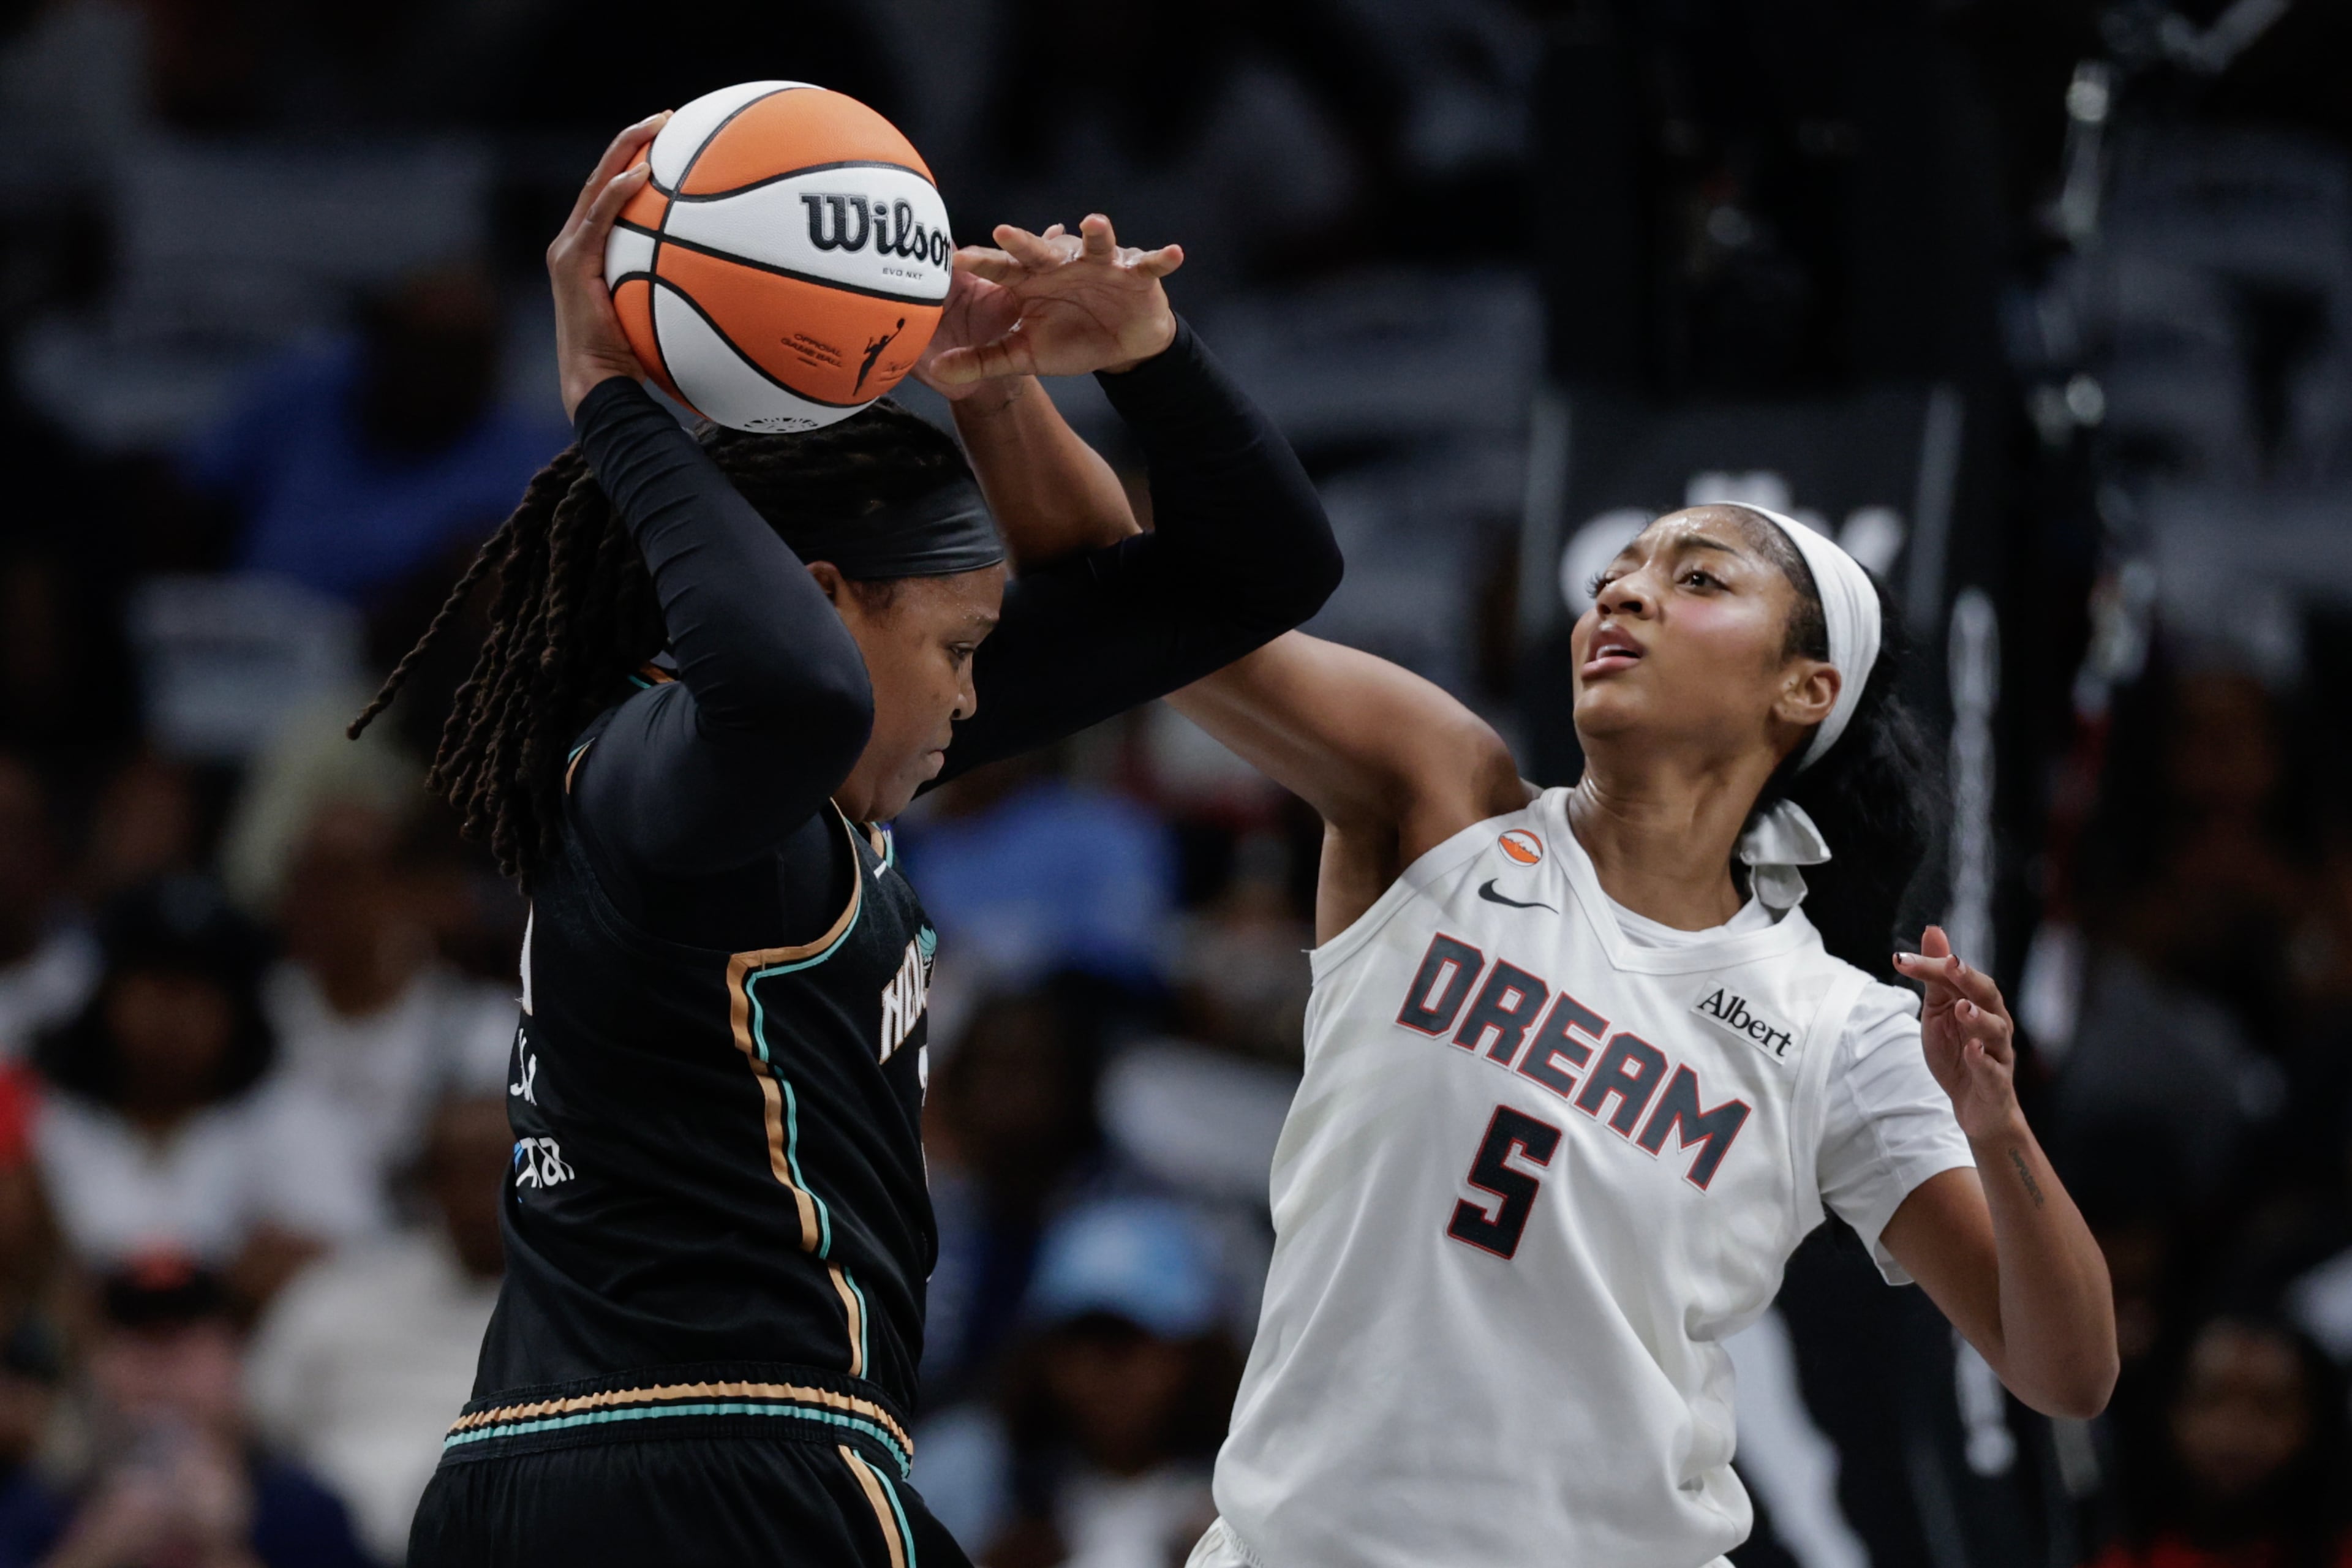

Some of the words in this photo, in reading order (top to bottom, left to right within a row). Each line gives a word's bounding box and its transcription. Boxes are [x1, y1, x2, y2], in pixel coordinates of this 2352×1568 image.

[883, 267, 903, 277] EVO
[906, 271, 923, 281] NXT
[780, 337, 816, 356] GAME
[816, 353, 842, 368] BALL
[794, 333, 842, 357] OFFICIAL
[1697, 988, 1792, 1057] Albert
[1394, 932, 1752, 1192] DREAM
[1446, 1104, 1562, 1261] 5
